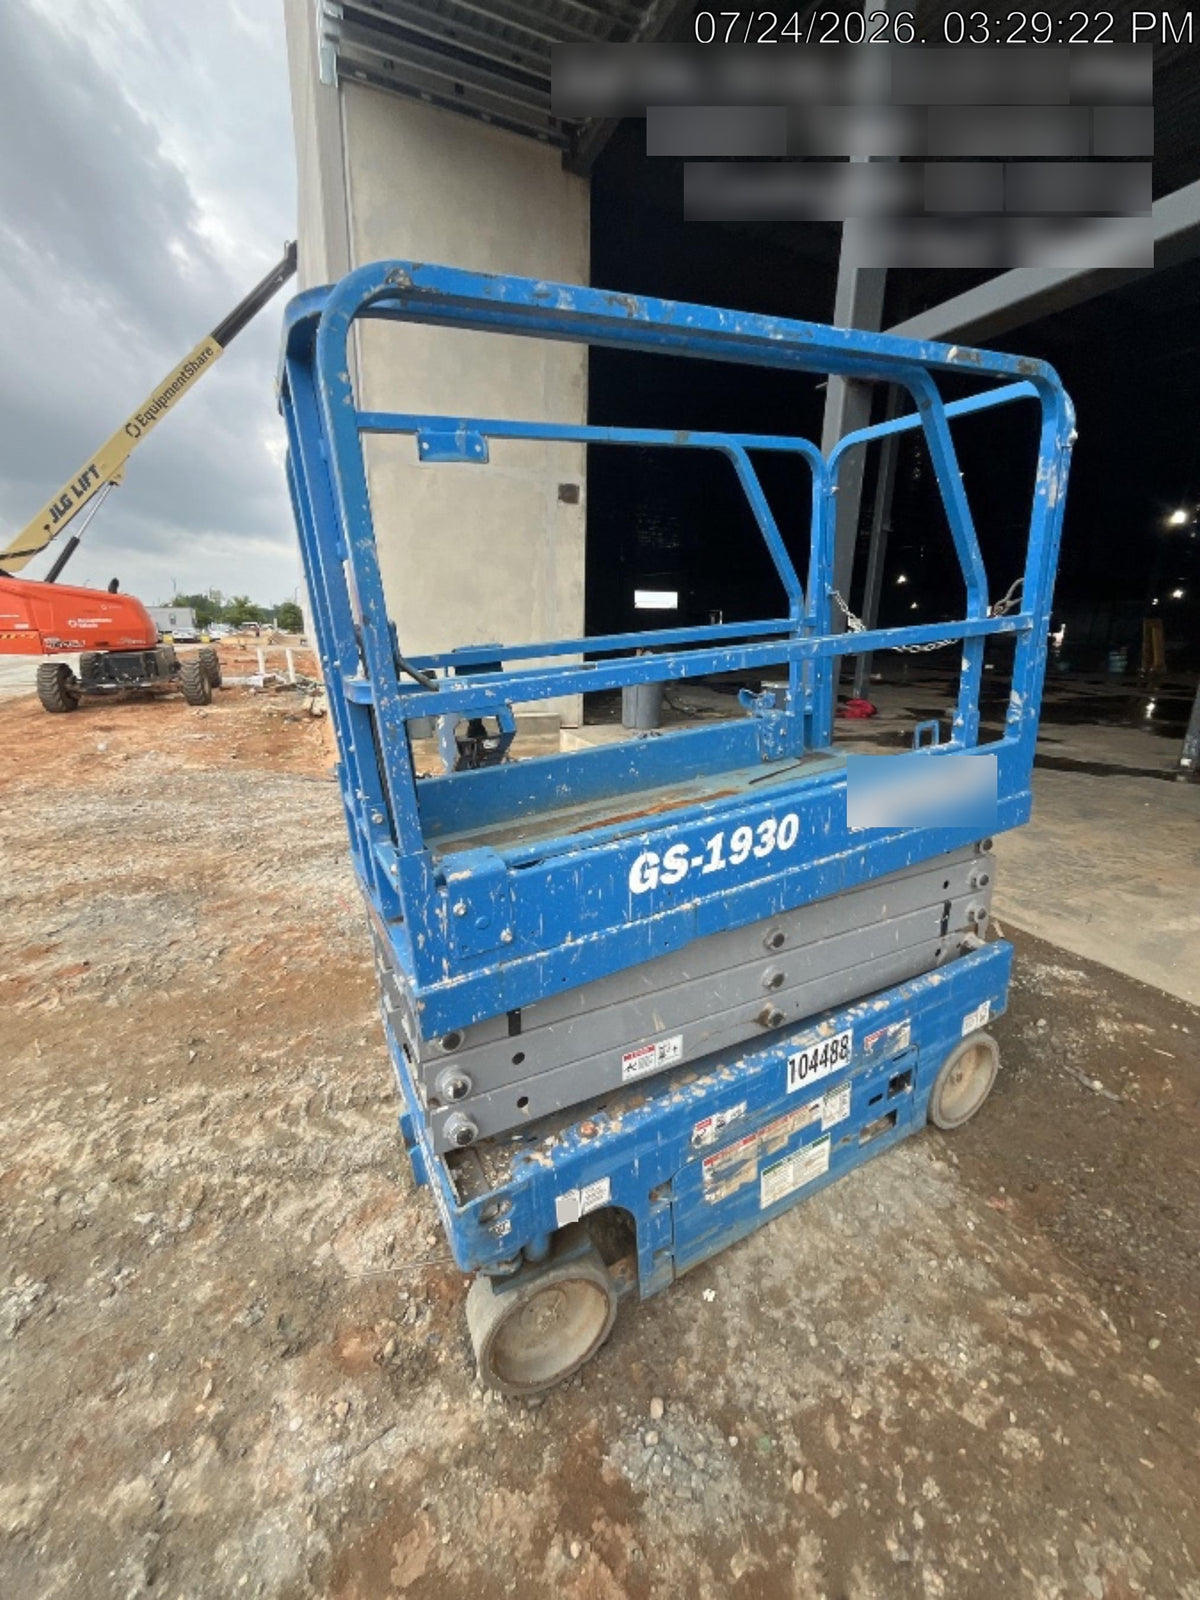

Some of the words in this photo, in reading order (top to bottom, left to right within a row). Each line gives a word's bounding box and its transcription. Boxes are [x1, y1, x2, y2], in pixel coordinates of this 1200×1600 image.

[134, 346, 214, 428] EquipmentShare
[49, 493, 74, 524] JLG
[70, 464, 101, 500] LIFT
[628, 813, 800, 894] GS-1930
[789, 1034, 850, 1084] 104488
